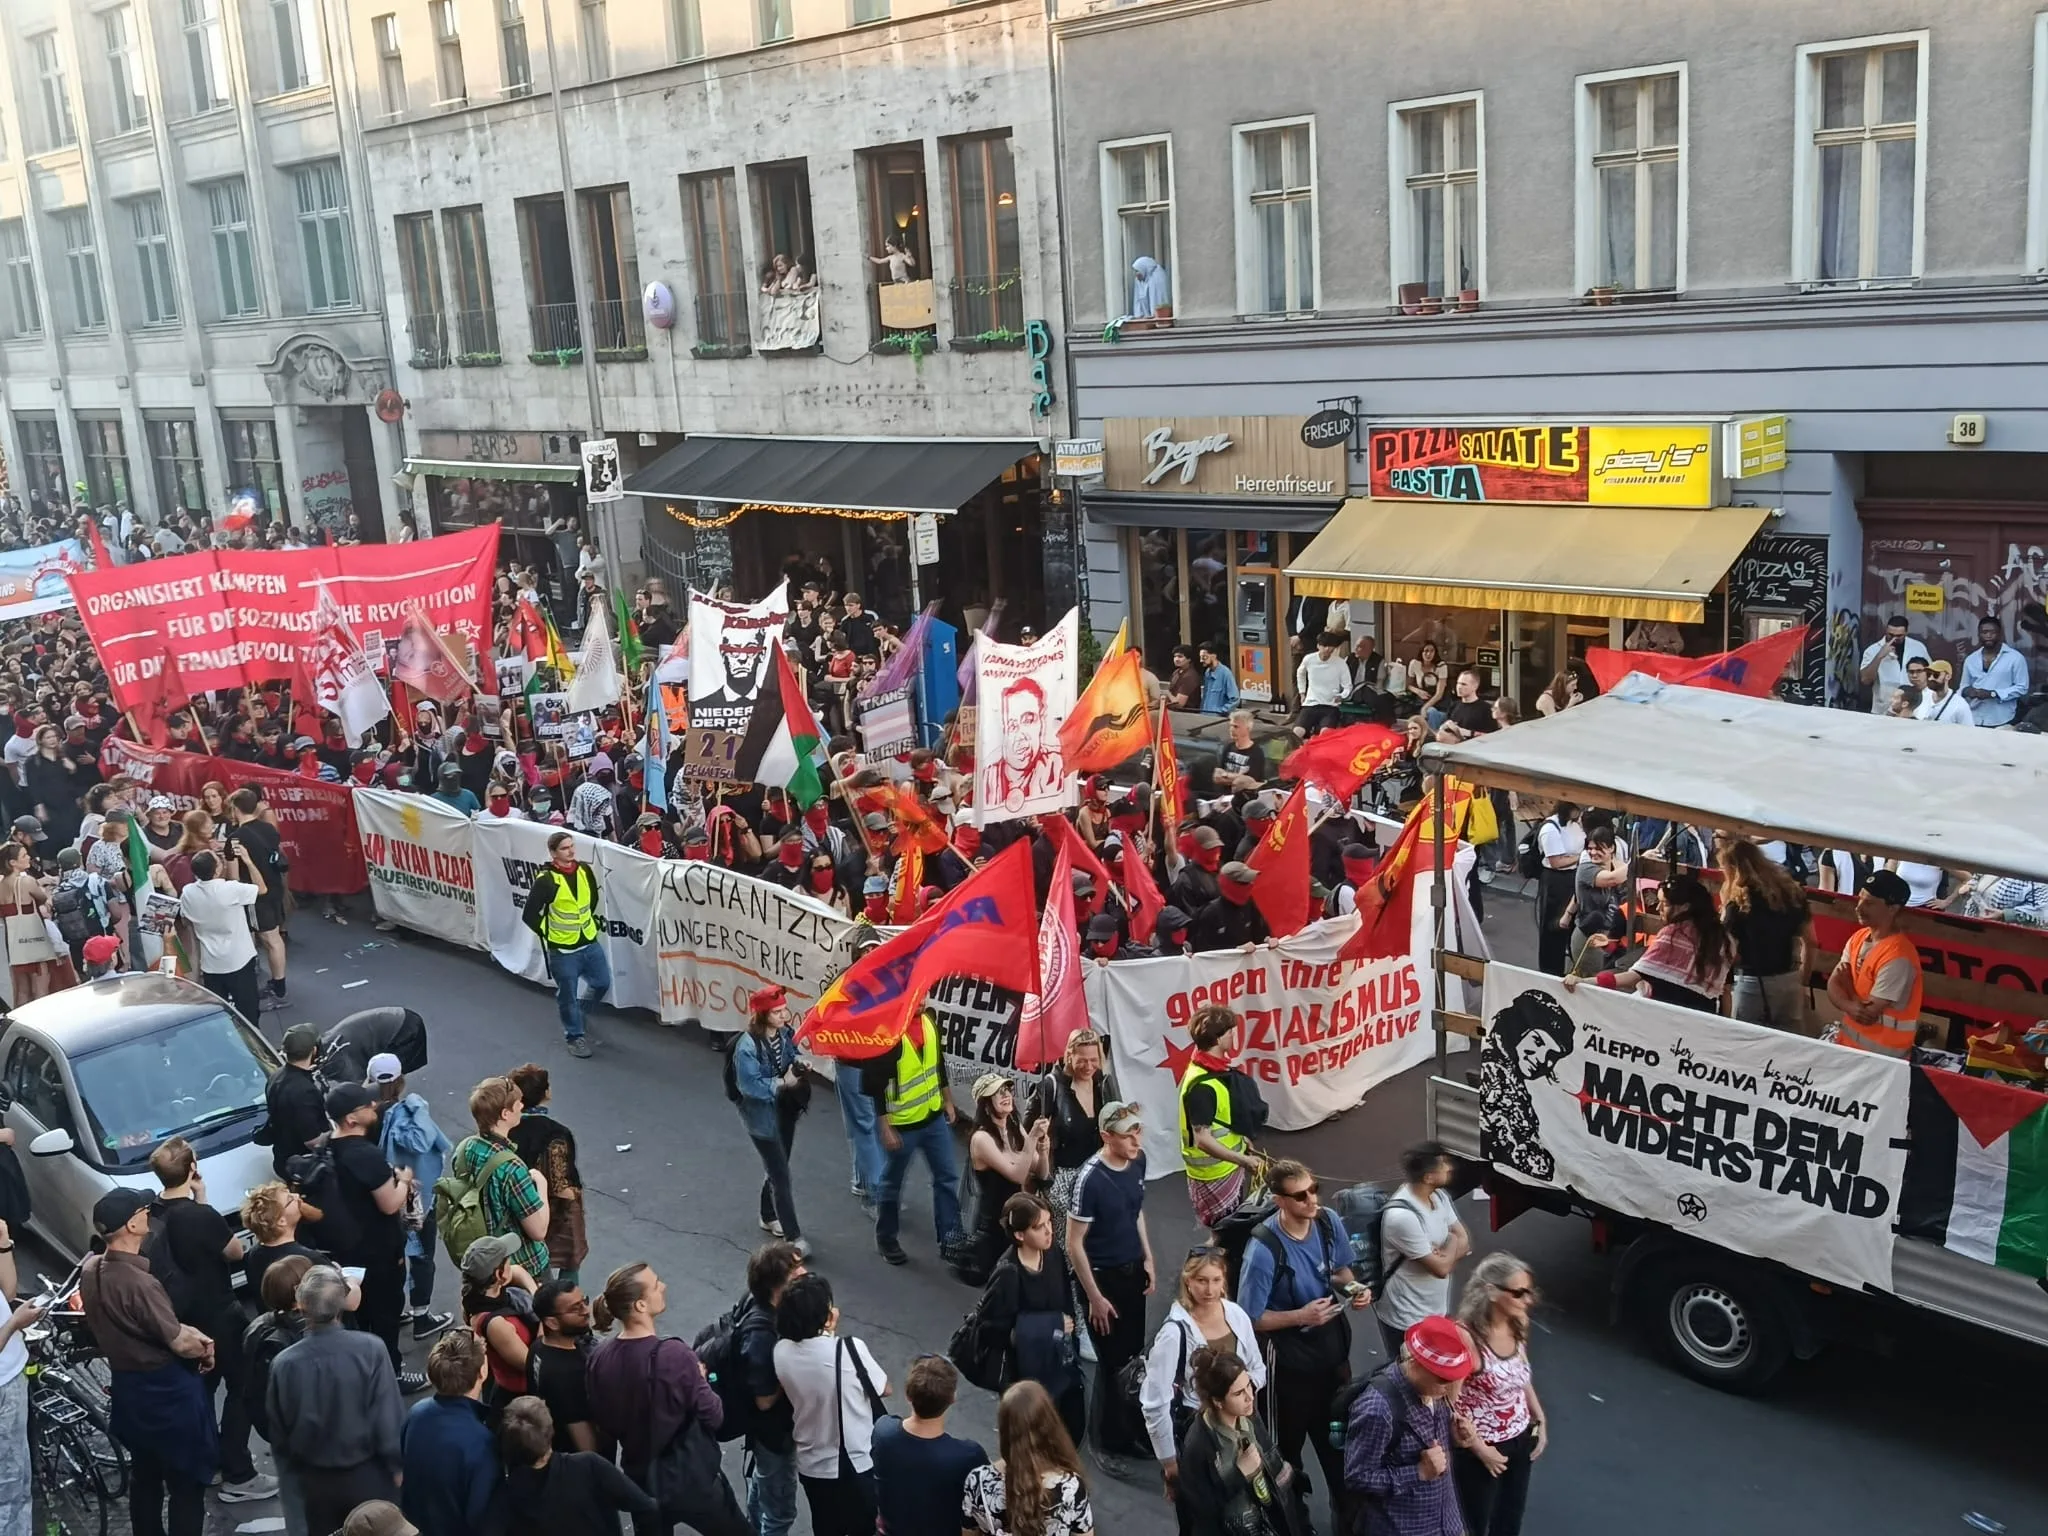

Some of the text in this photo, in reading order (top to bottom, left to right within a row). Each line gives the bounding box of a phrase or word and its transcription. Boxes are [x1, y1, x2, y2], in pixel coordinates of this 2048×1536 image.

[1026, 319, 1051, 418] Bar
[1304, 418, 1350, 442] FRISEUR
[1960, 422, 1976, 437] 38
[1056, 441, 1101, 456] ATM ATM
[1374, 426, 1580, 472] PIZZA SALATE
[1057, 457, 1080, 472] Cash
[1235, 473, 1333, 493] Herrenfriseur
[1391, 464, 1485, 500] PASTA
[208, 569, 287, 595] KÄMPFEN
[1744, 557, 1793, 581] PIZZA
[87, 576, 204, 616] ORGANISIERT
[167, 612, 207, 639] FÜR
[859, 686, 908, 711] TRANS
[1242, 678, 1272, 694] Cash
[691, 717, 726, 729] DER
[1165, 959, 1343, 1029] gegen ihre
[1228, 963, 1421, 1060] OZIALISMUS
[1286, 1010, 1421, 1087] perspektive
[1584, 1034, 1879, 1123] ALEPPO ROJAVA ROJHILAT
[1763, 1059, 1783, 1081] bis
[1785, 1067, 1814, 1088] nach
[1584, 1061, 1864, 1176] MACHT DEM
[1582, 1100, 1890, 1219] WIDERSTAND
